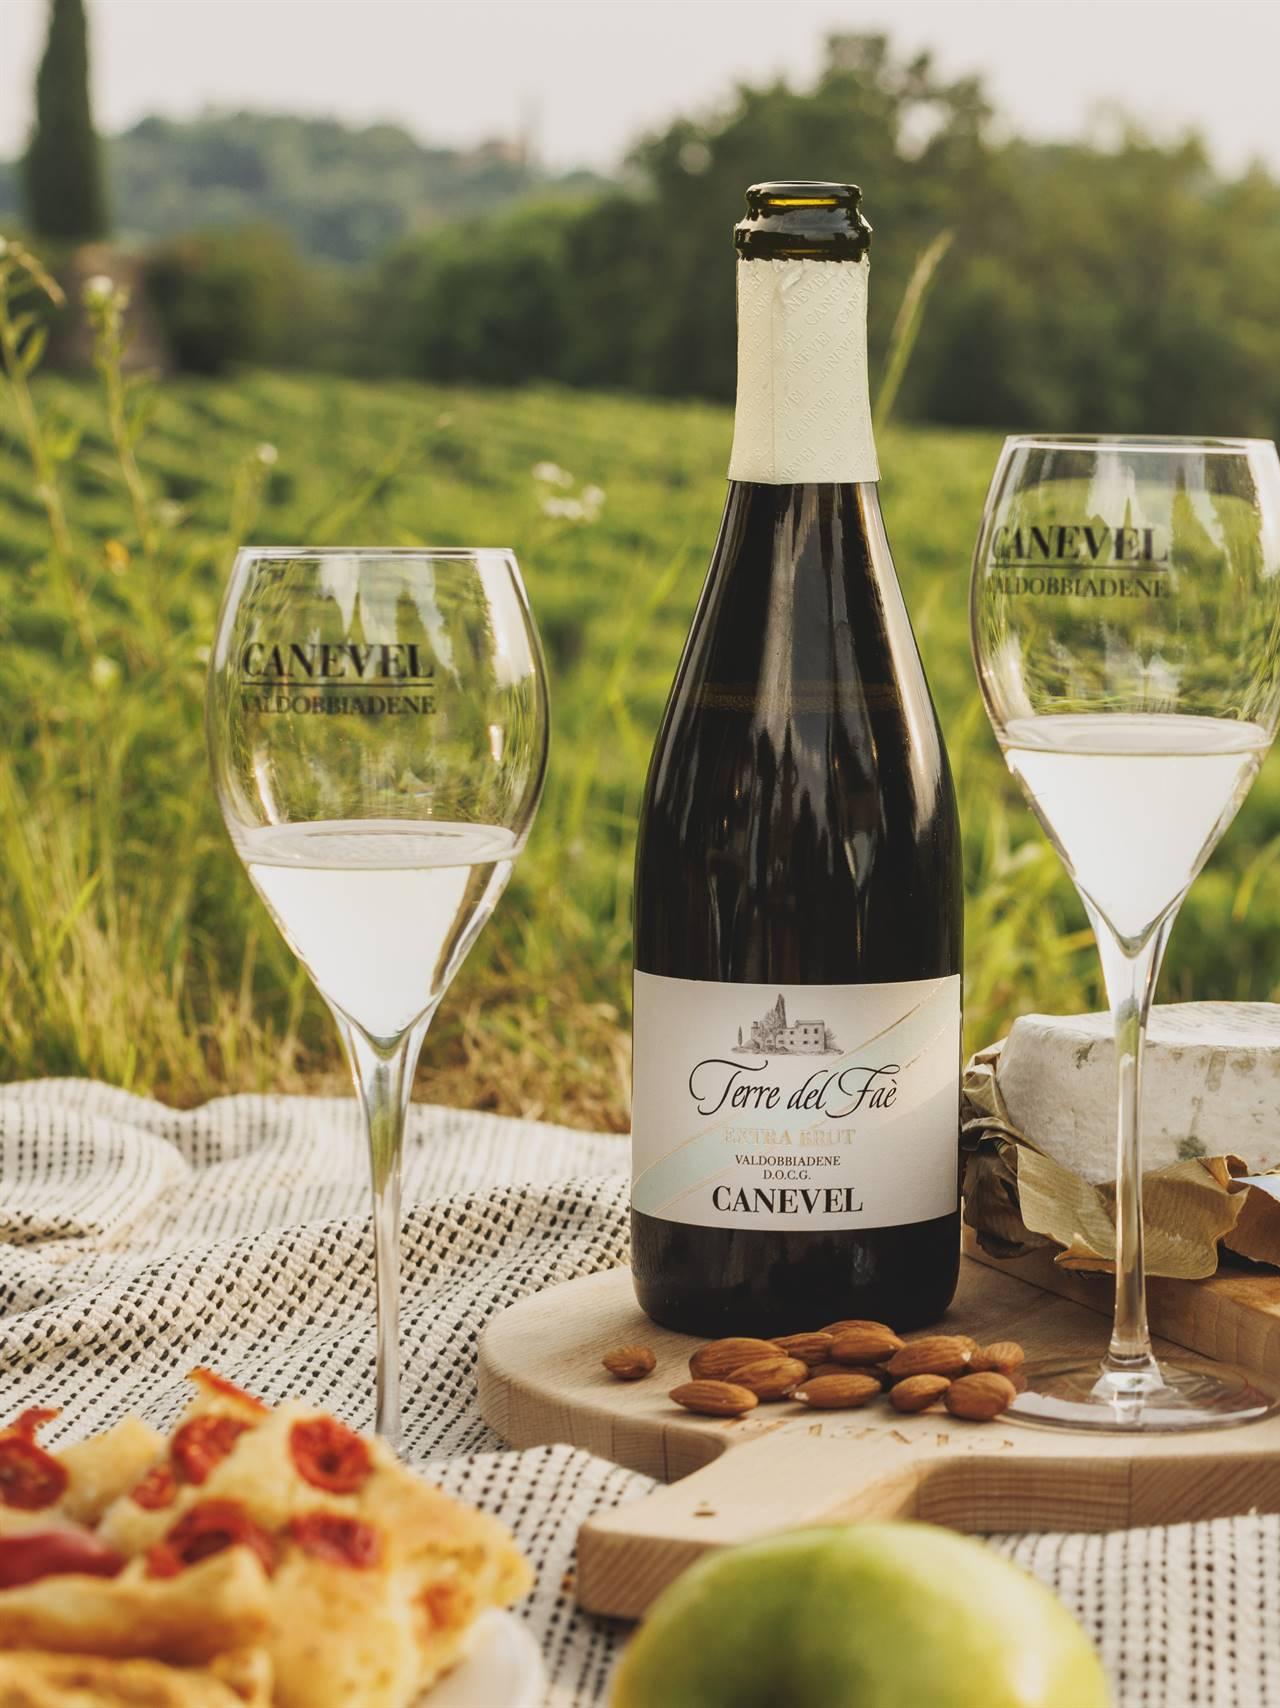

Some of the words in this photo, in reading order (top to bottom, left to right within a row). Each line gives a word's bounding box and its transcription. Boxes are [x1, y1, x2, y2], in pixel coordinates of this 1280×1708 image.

[992, 525, 1169, 562] CANEVEL
[243, 642, 435, 678] CANEVEL
[689, 1059, 780, 1116] Terre
[787, 1069, 839, 1110] del
[720, 1126, 792, 1146] EXTRA
[800, 1128, 856, 1146] BRUT
[734, 1154, 841, 1167] VALDOBBIADENE
[763, 1169, 811, 1181] D.O.C.G.
[712, 1185, 863, 1214] CANEVEL
